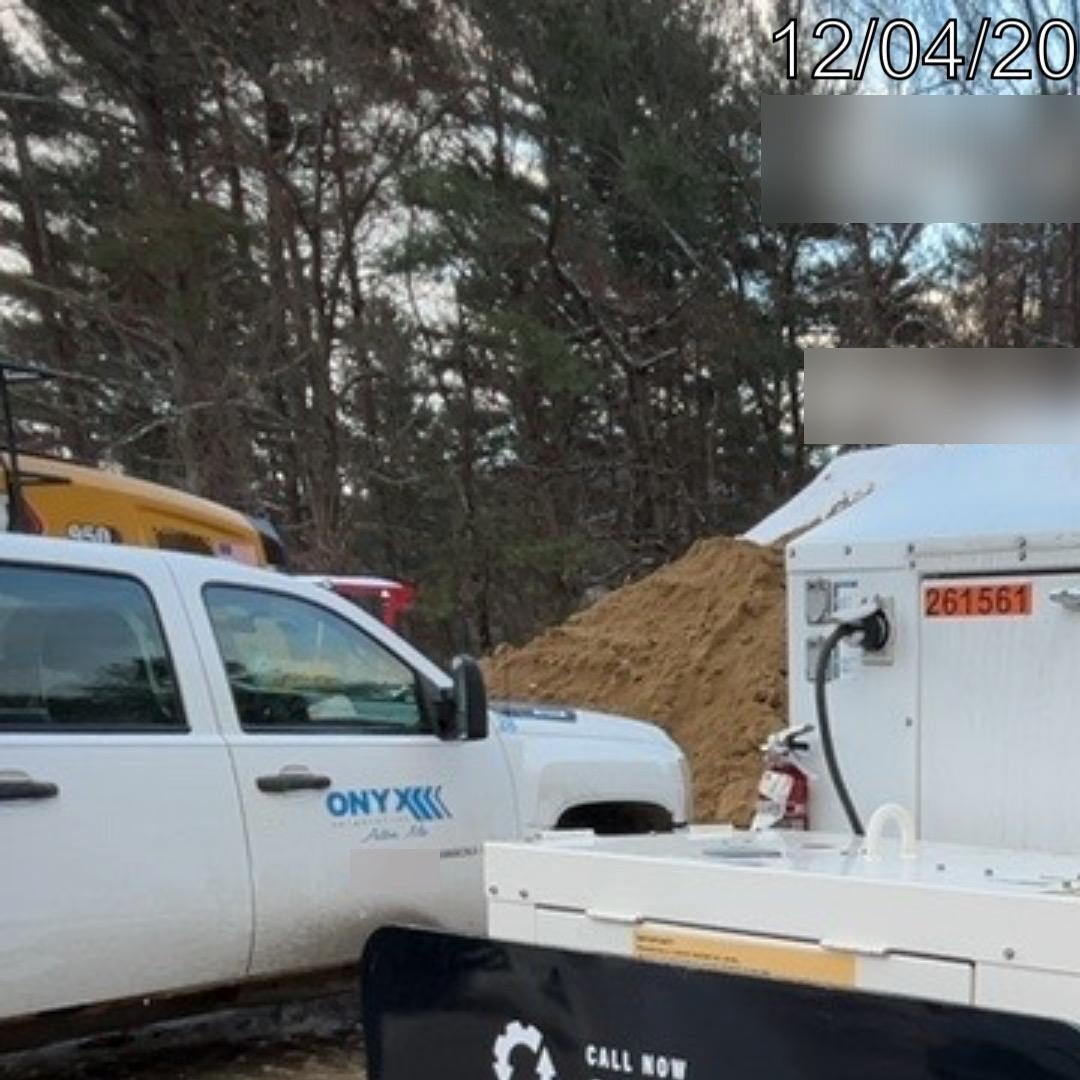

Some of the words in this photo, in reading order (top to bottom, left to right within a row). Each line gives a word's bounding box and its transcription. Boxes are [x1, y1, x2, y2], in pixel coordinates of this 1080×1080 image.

[926, 585, 1026, 616] 261561
[327, 785, 421, 819] ONYX
[584, 1044, 634, 1073] CALL
